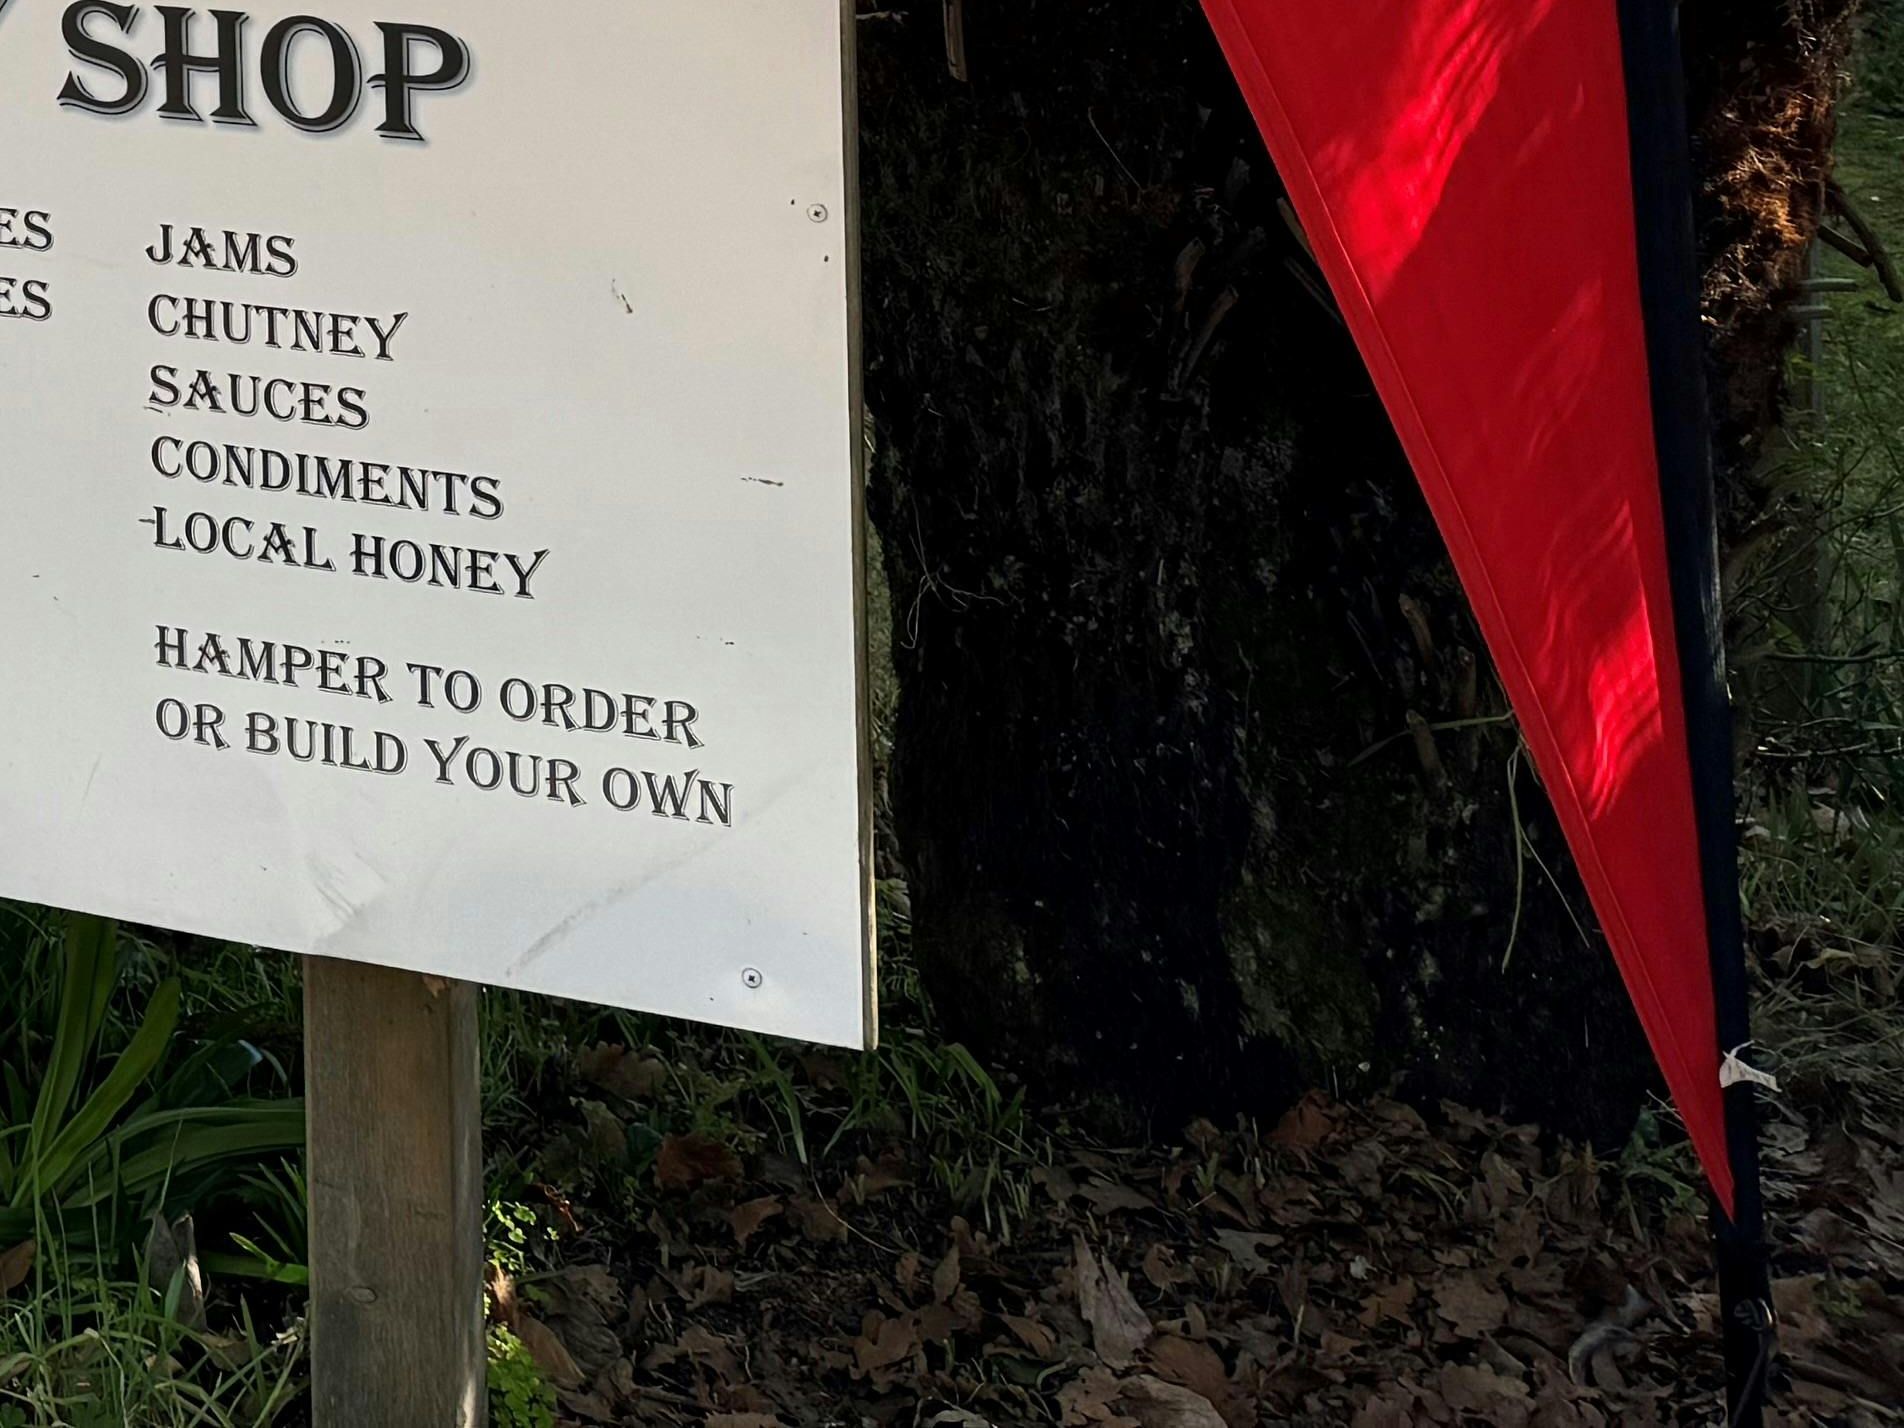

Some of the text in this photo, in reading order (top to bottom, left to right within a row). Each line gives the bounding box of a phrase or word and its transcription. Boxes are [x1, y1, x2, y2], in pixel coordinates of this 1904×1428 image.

[145, 224, 298, 278] JAMS
[147, 294, 408, 361] CHUTNEY
[148, 365, 370, 430] SAUCES
[151, 436, 504, 520] CONDIMENTS
[153, 506, 550, 599] LOCAL HONEY
[155, 625, 705, 750] HAMPER TO ORDER
[155, 697, 735, 827] OR BUILD YOUR OWN
